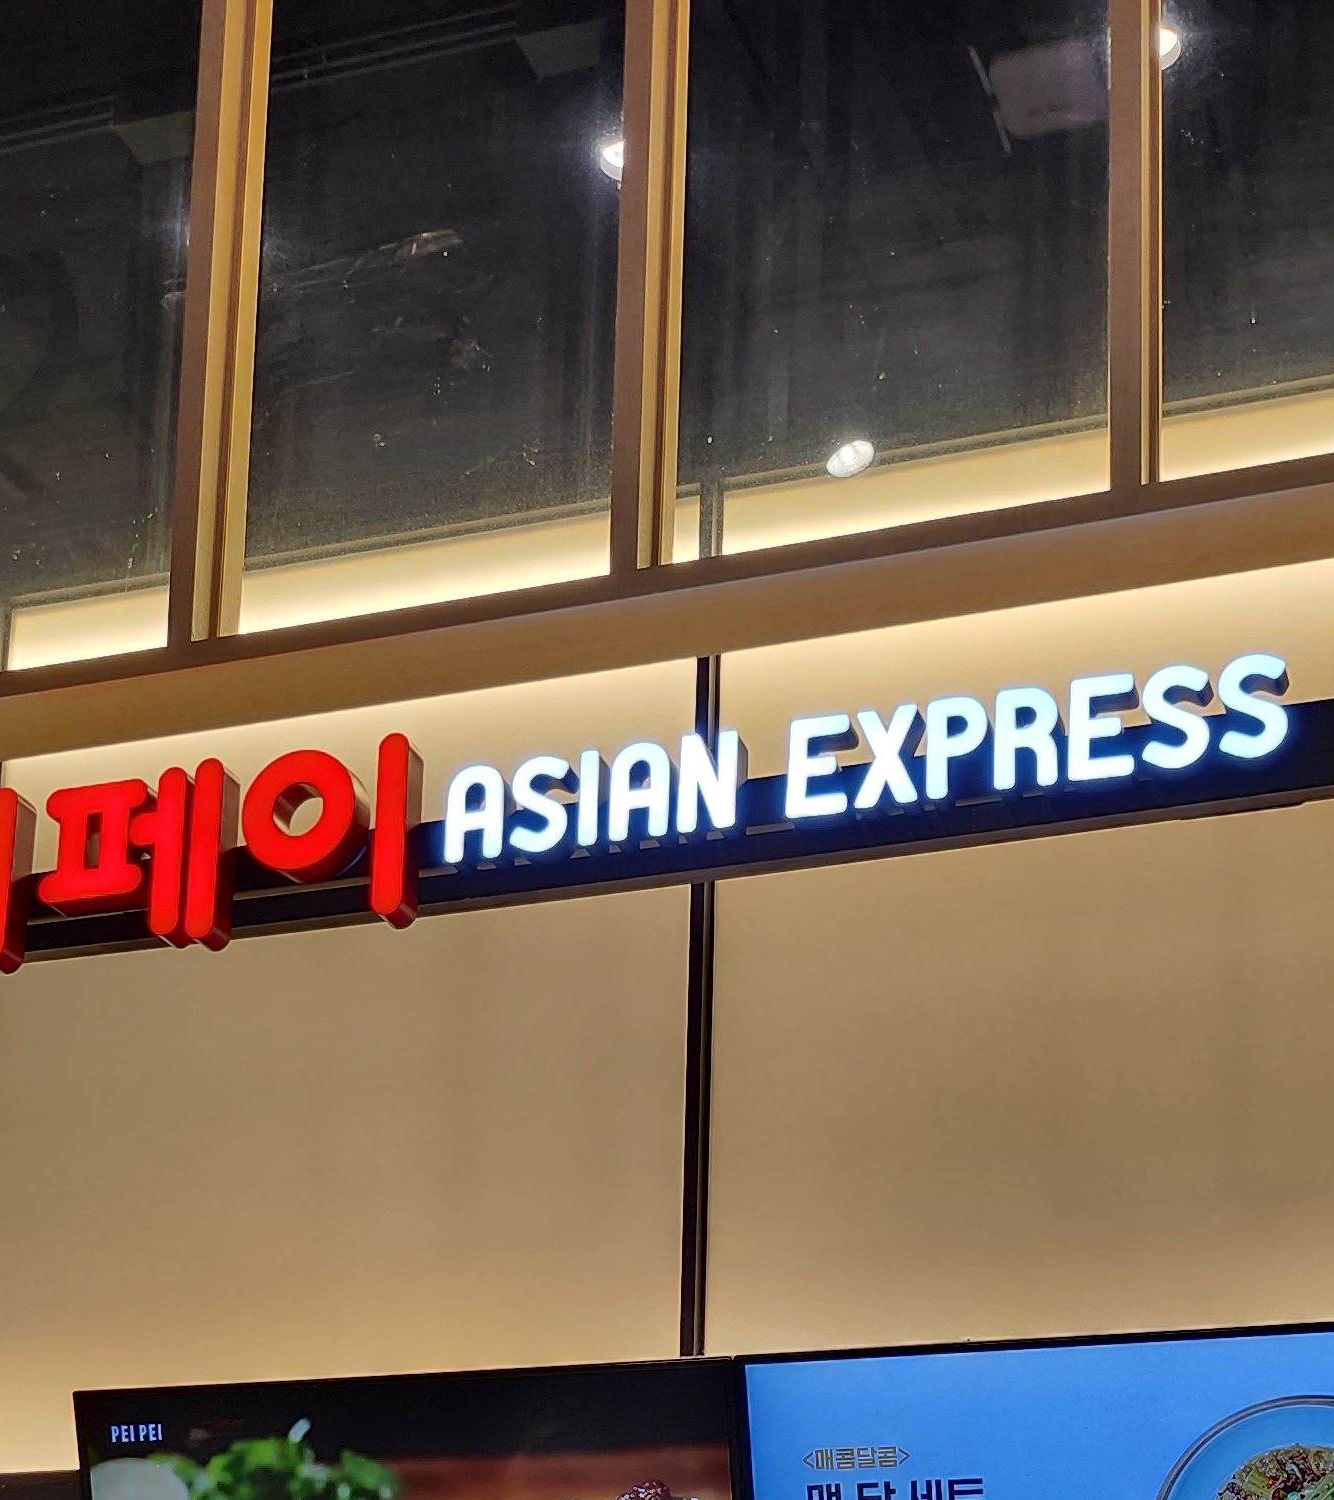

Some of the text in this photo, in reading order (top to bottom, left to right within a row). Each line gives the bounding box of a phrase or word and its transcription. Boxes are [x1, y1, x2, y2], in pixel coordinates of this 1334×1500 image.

[442, 652, 1289, 864] ASIAN EXPRESS
[110, 1422, 164, 1444] PEI PEI
